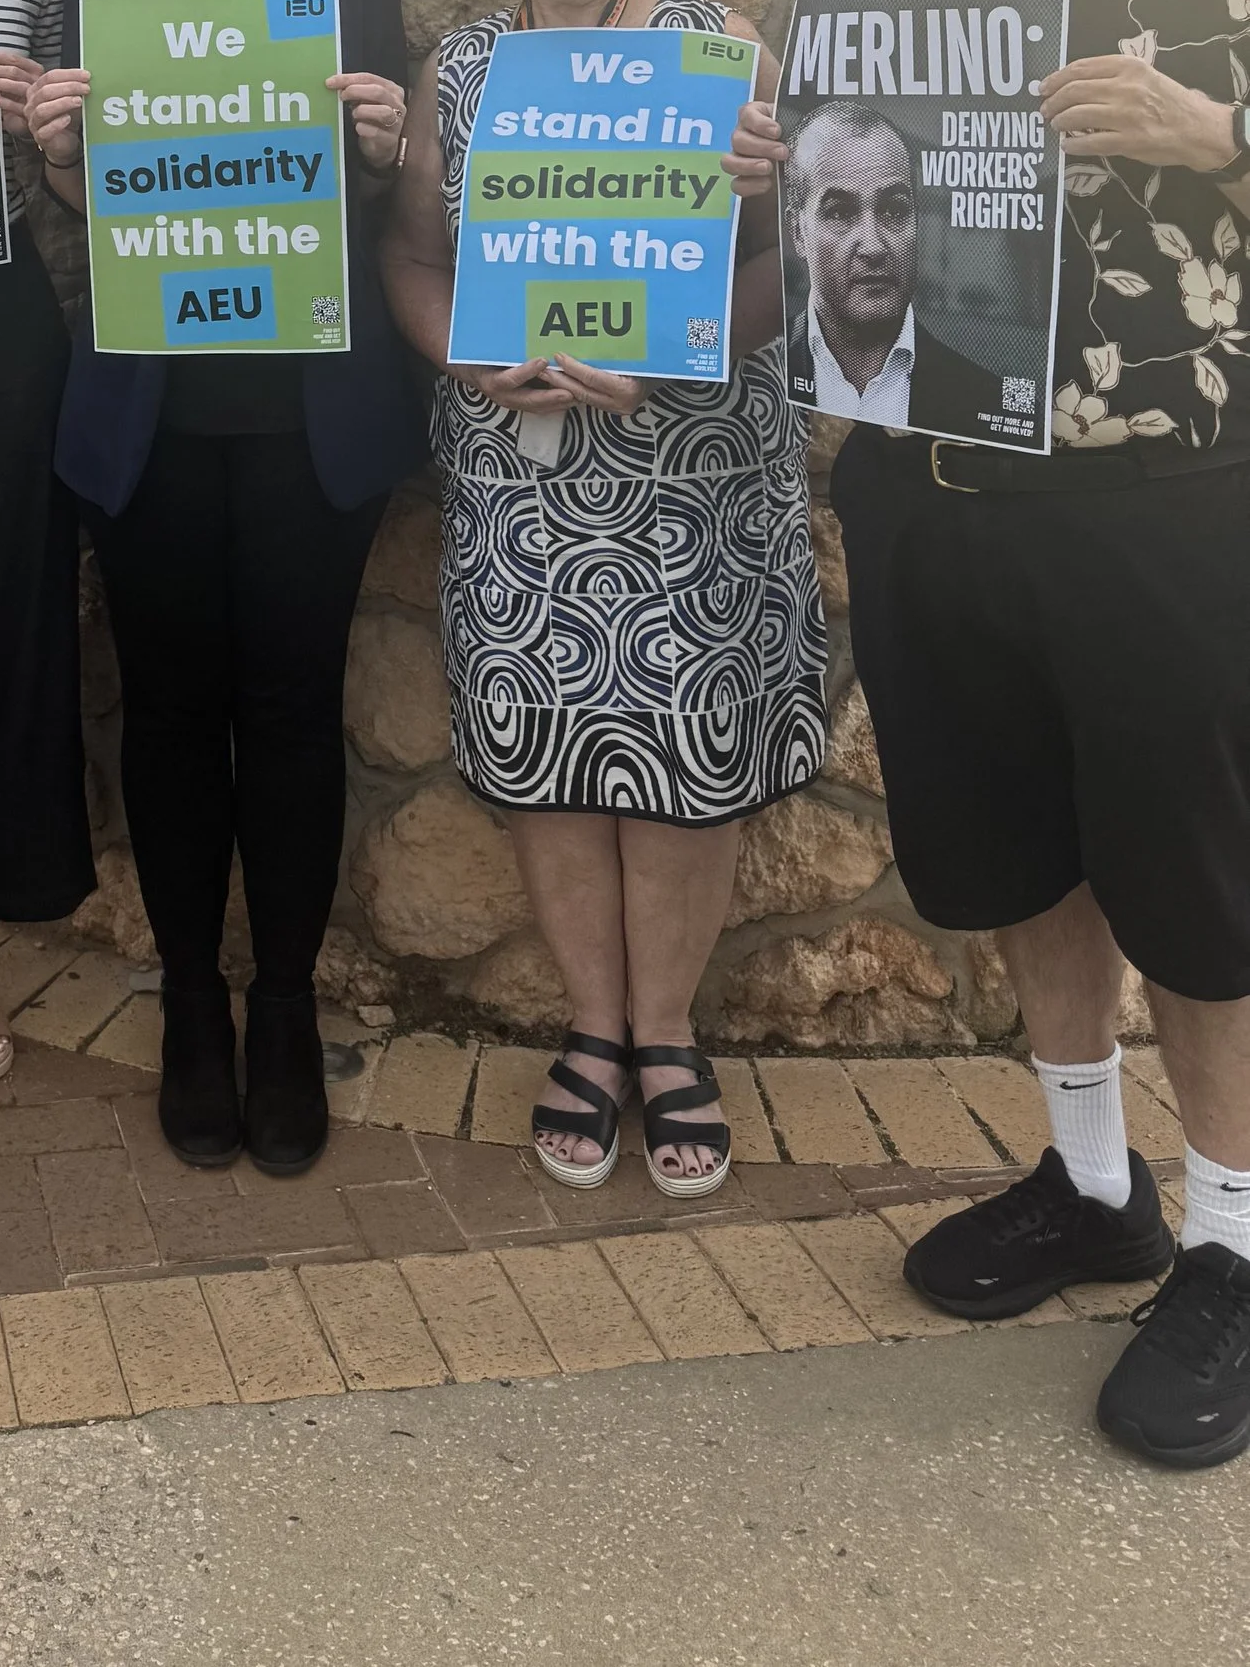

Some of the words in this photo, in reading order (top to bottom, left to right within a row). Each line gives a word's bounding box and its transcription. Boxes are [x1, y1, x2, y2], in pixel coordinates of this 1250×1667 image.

[162, 21, 246, 58] We
[702, 41, 745, 63] IEU
[788, 6, 1043, 97] MERLINO:
[570, 52, 654, 84] We
[102, 84, 250, 126] stand
[262, 80, 310, 122] in
[492, 106, 650, 142] stand
[661, 106, 713, 146] in
[942, 111, 1045, 149] DENYING
[104, 146, 323, 196] solidarity
[481, 164, 720, 210] solidarity
[921, 150, 1044, 190] WORKERS'
[951, 191, 1044, 231] RIGHTS!
[111, 215, 224, 257] with
[234, 216, 320, 255] the
[481, 221, 597, 266] with
[610, 230, 704, 272] the
[176, 286, 262, 324] AEU
[539, 301, 632, 337] AEU
[794, 376, 814, 393] IEU
[977, 412, 991, 421] FIND
[992, 415, 1003, 423] OUT
[1004, 417, 1021, 426] MORE
[1022, 420, 1034, 429] AND
[990, 423, 1002, 432] GET
[1003, 425, 1034, 437] INVOLVED!
